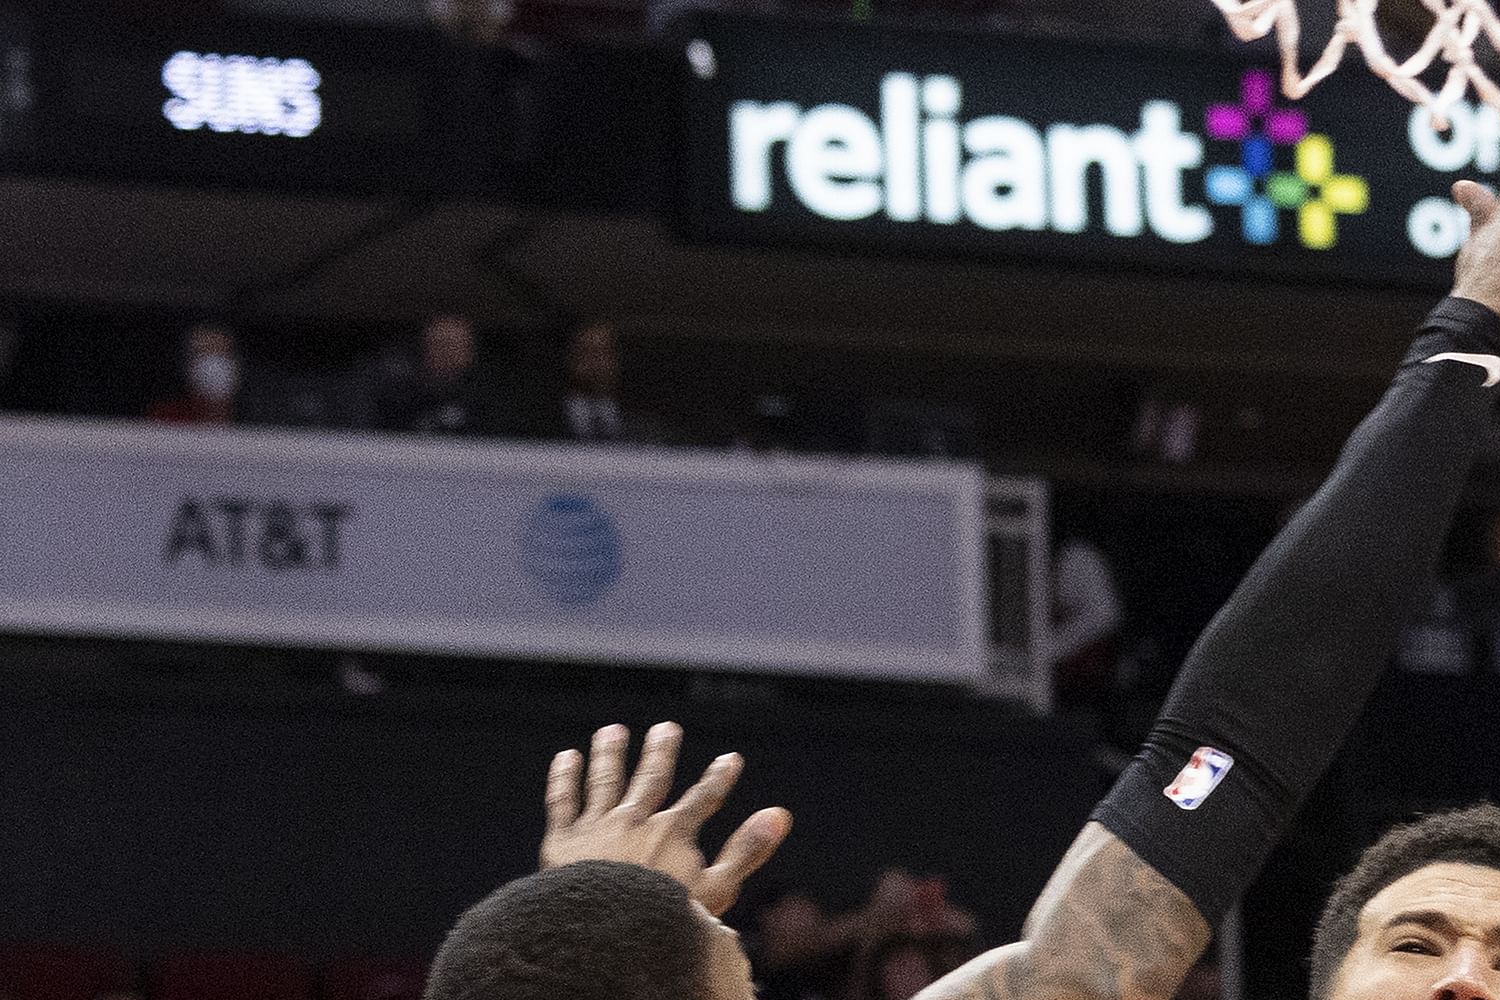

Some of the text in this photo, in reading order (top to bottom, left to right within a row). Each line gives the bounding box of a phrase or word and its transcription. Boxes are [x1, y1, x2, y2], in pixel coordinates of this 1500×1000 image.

[161, 50, 322, 137] SUNS
[729, 72, 1213, 243] reliant
[163, 494, 355, 570] AT&T
